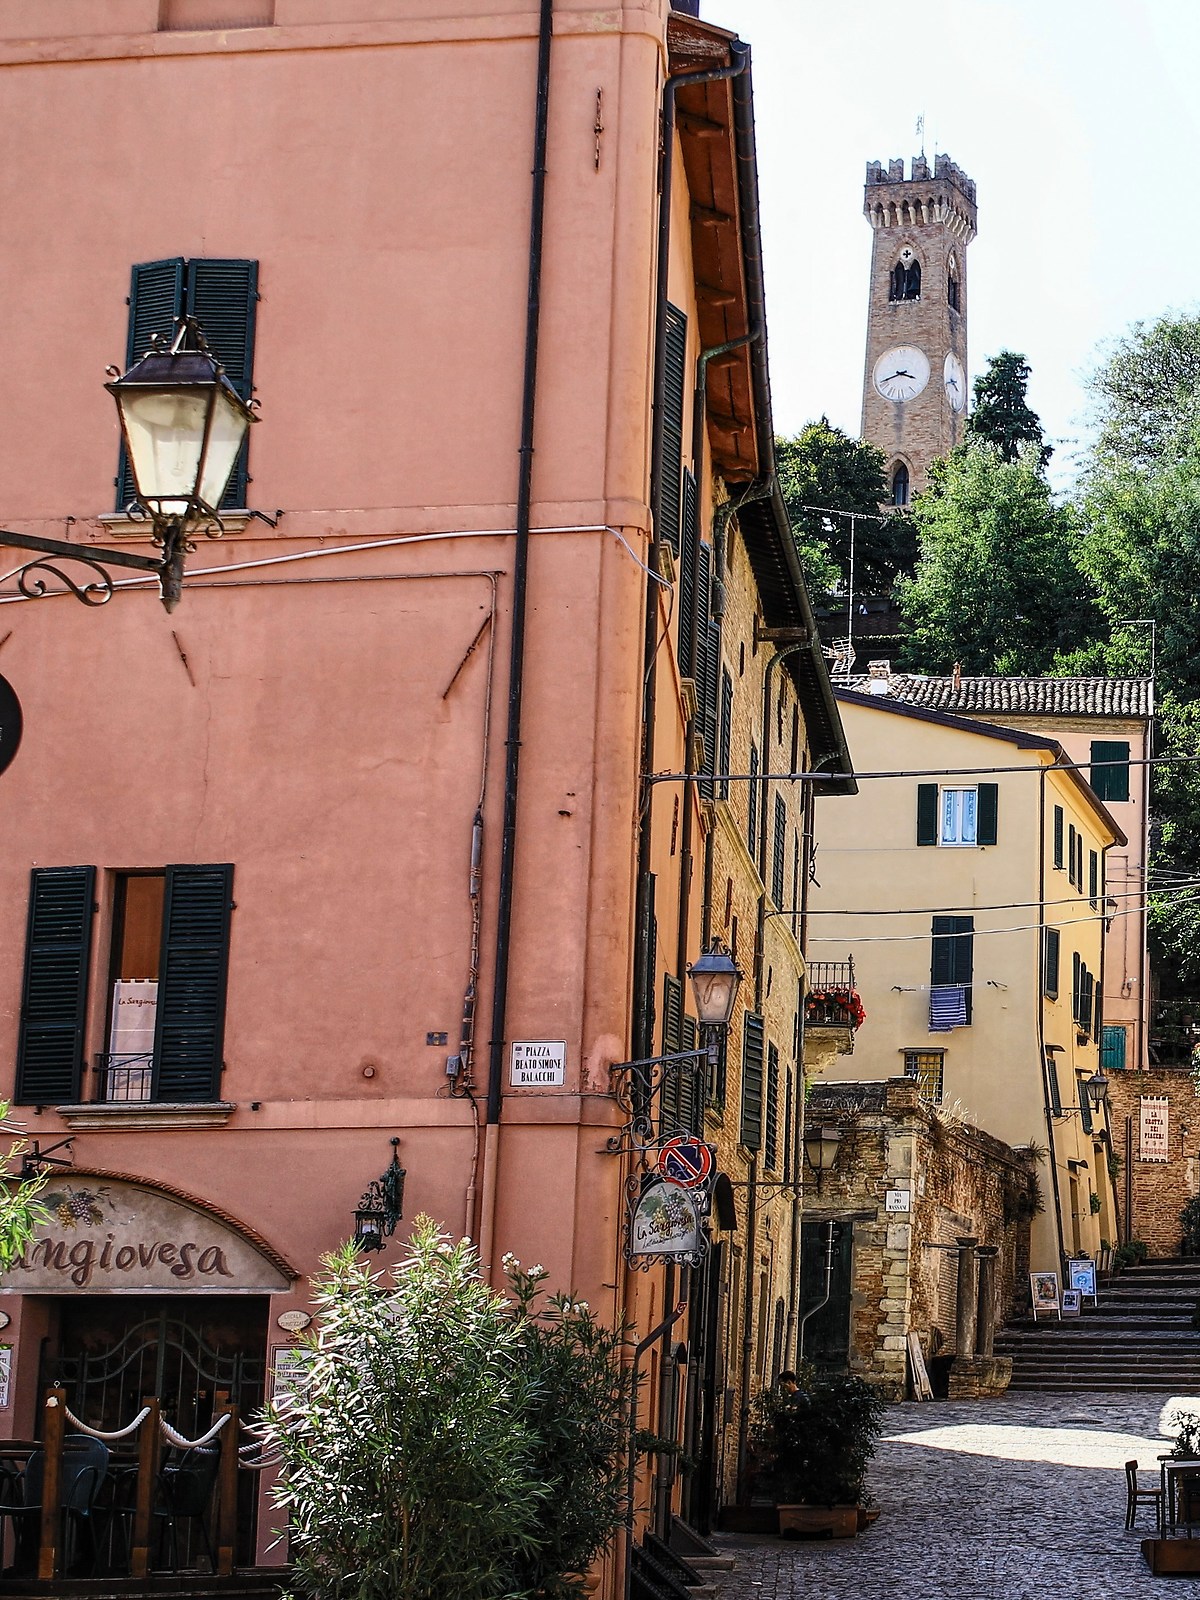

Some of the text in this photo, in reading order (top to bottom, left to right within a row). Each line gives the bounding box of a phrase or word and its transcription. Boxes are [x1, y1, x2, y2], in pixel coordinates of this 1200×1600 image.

[525, 1046, 551, 1057] PIAZZA
[515, 1058, 562, 1070] BEATO SIMONE
[521, 1071, 555, 1082] BALACCHI
[10, 1232, 235, 1288] angiovesa
